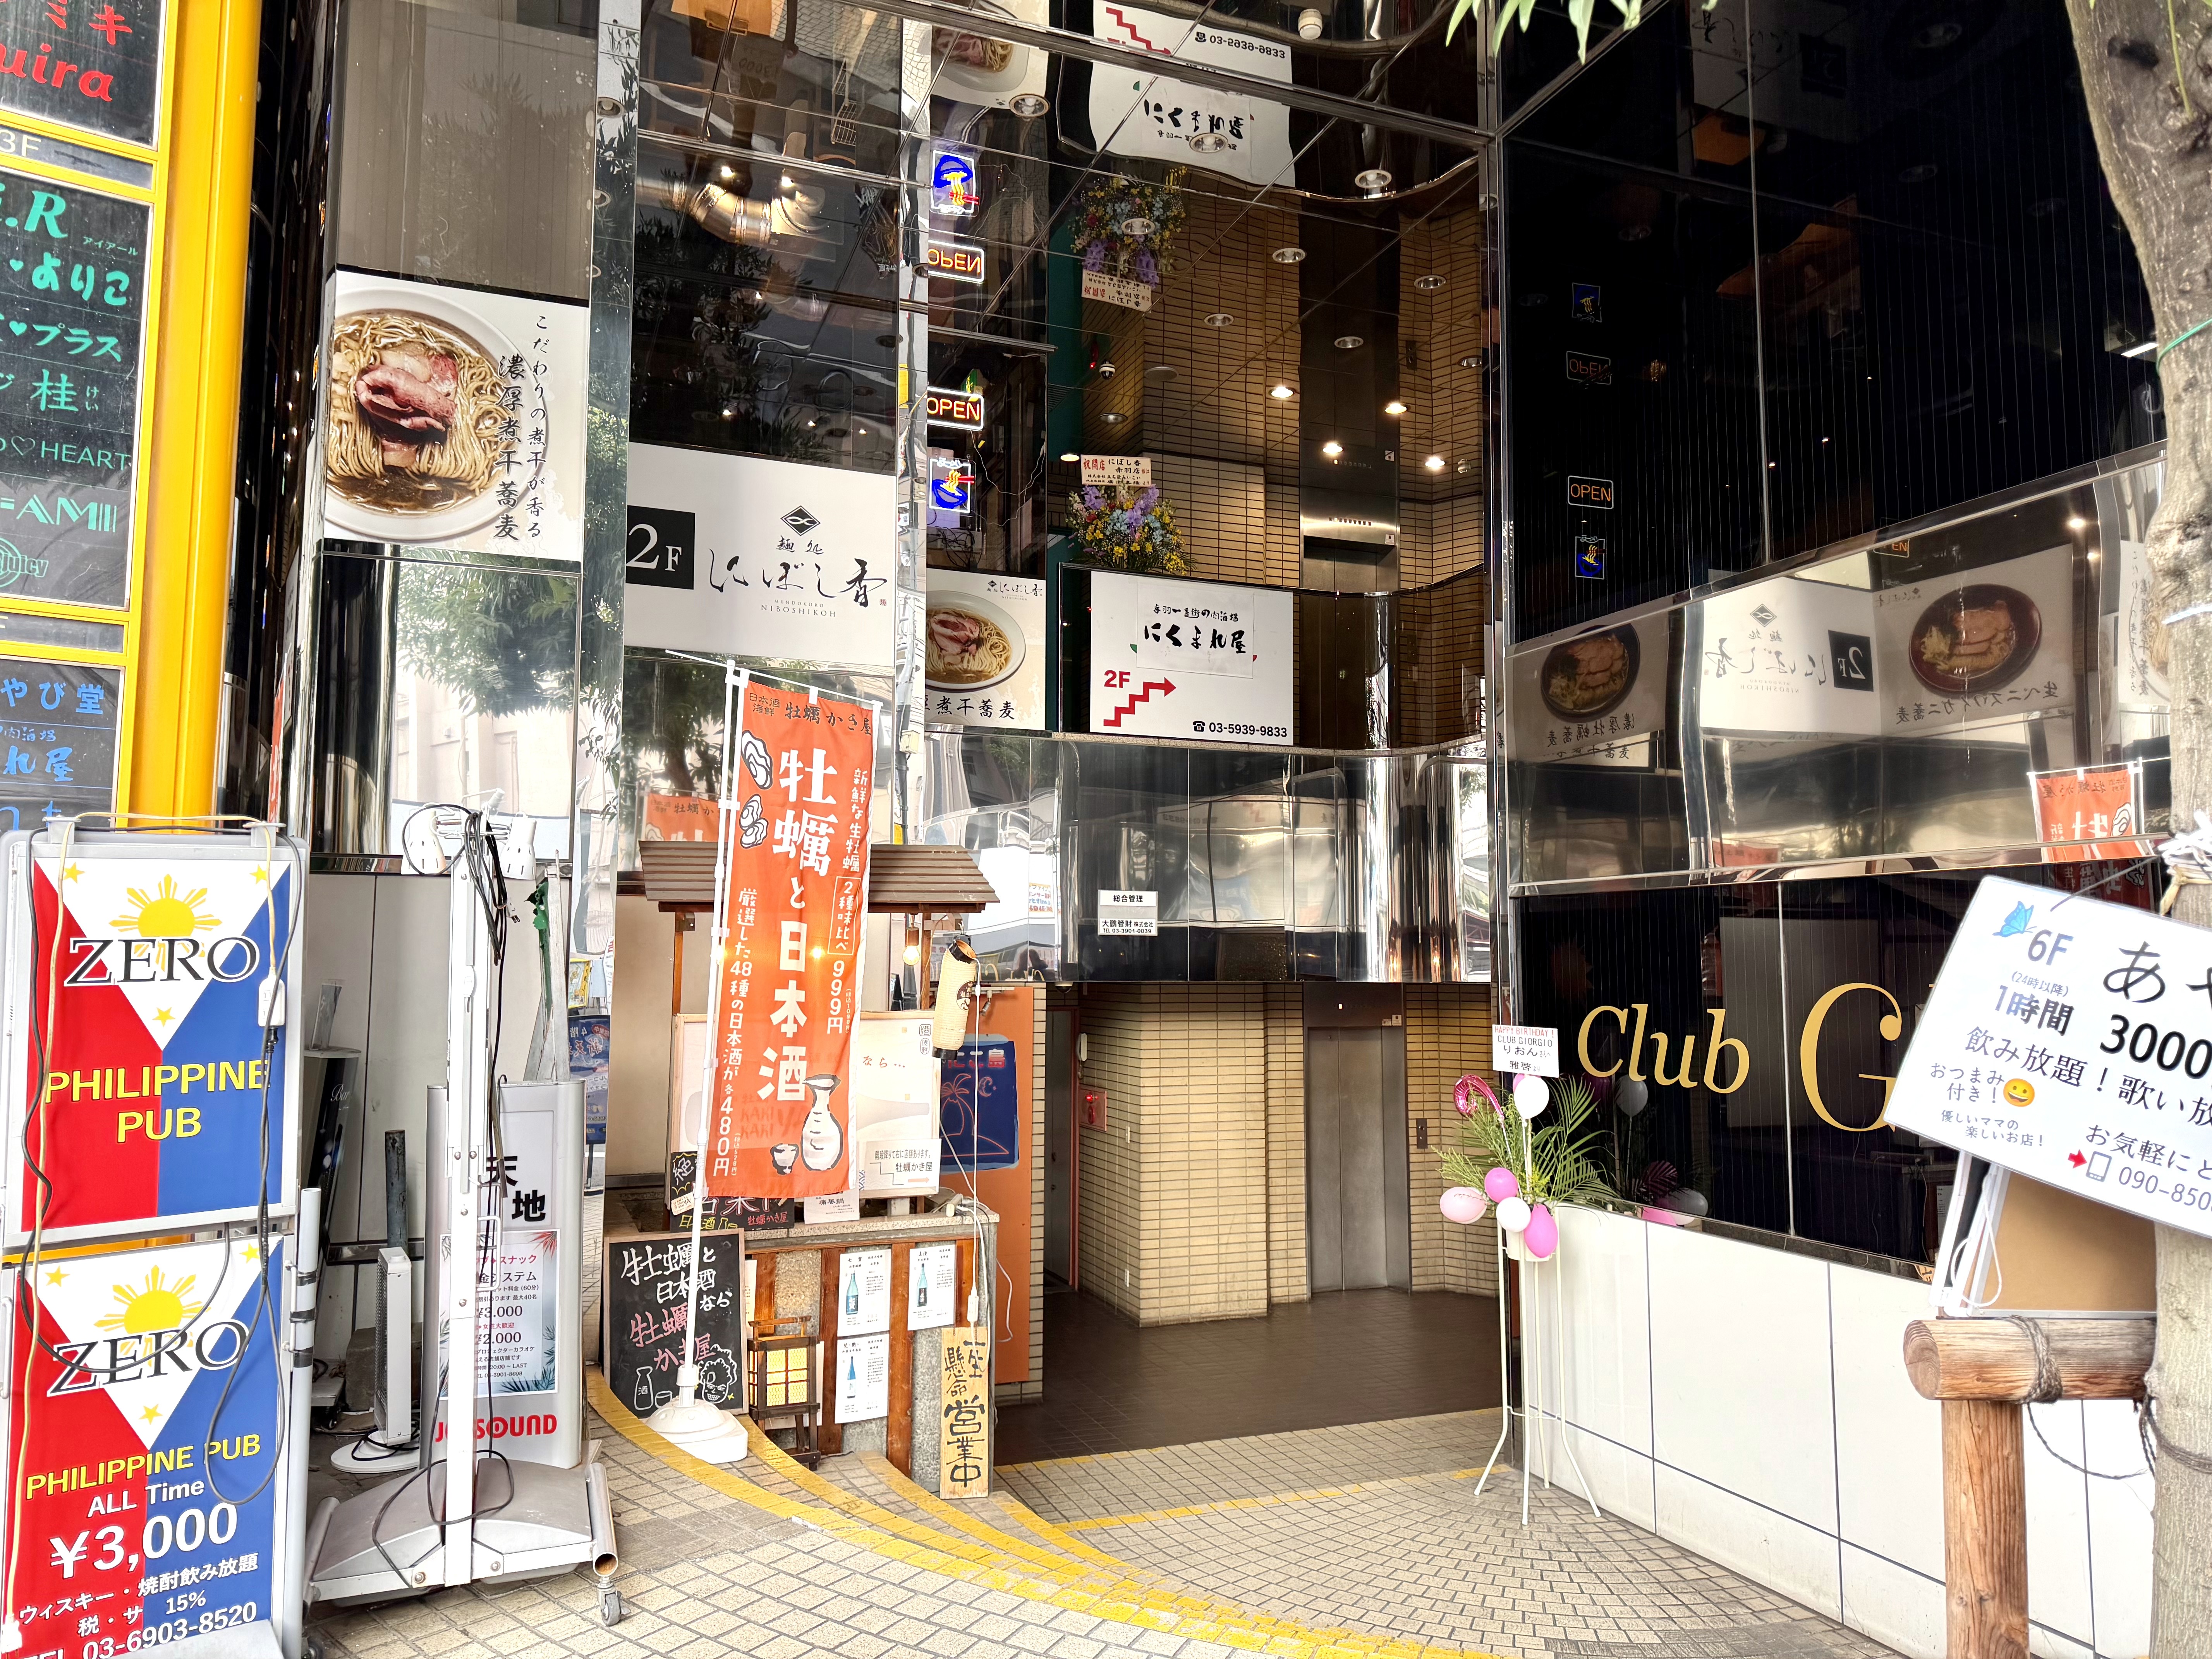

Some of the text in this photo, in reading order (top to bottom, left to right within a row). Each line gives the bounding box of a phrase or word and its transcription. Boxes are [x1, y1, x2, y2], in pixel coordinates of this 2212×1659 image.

[83, 236, 138, 256] アイアール
[32, 252, 130, 306] よりこ
[33, 322, 122, 362] プラス
[525, 314, 550, 538] こだわりの煮干が香る
[926, 397, 981, 421] OPEN
[41, 440, 132, 471] HEART
[493, 354, 526, 541] 濃厚煮干蕎麦
[1083, 458, 1105, 471] 祝開店
[1570, 484, 1611, 501] OPEN
[625, 523, 683, 572] 2F
[708, 548, 888, 608] にぼし香
[761, 603, 836, 618] NIBOSHIKOH
[774, 598, 825, 608] MENDOKORO
[1144, 622, 1247, 654] にくまれ屋
[1103, 670, 1131, 689] 2F
[749, 692, 872, 735] 日本酒 牡蠣かき屋
[752, 704, 775, 716] 海鮮
[1209, 722, 1288, 737] 03-5939-9833
[842, 768, 868, 872] 新鮮な生牡蠣
[1113, 895, 1144, 903] 総合管理
[757, 748, 838, 1101] 牡蠣と日本酒
[64, 936, 259, 986] ZERO
[2027, 929, 2074, 966] 6F
[2011, 970, 2069, 998] (24時以降)
[1994, 984, 2075, 1036] 1時間
[921, 1025, 931, 1036] 酒
[1495, 1026, 1514, 1034] HAPPY
[1516, 1027, 1548, 1037] BIRTHDAY
[1498, 1035, 1553, 1047] CLUB GIORGIO
[1577, 1003, 1750, 1094] Club
[45, 1059, 269, 1104] PHILIPPINE
[1930, 1062, 2005, 1087] おつまみ
[117, 1107, 202, 1143] PUB
[1941, 1109, 2019, 1131] 優しいママの
[874, 1149, 931, 1161] 階段降りて右に店舗あります。
[895, 1161, 933, 1173] 牡蠣かき屋
[2119, 1166, 2212, 1212] 090-850
[679, 1211, 789, 1230] 日酒 牡蠣かき屋
[621, 1242, 716, 1286] 牡蠣と
[699, 1291, 733, 1311] なら
[630, 1301, 689, 1348] 牡蠣
[47, 1318, 250, 1397] ZERO
[637, 1385, 649, 1396] 酒
[435, 1414, 558, 1443] JSOUND
[943, 1394, 986, 1488] 営業中
[26, 1434, 261, 1500] PHILIPPINE PUB
[88, 1480, 205, 1518] ALL Time
[49, 1501, 238, 1579] ¥3,000
[19, 1552, 259, 1625] ウィスキー・焼酎飲み放題
[77, 1590, 206, 1638] 税・サ 15%
[83, 1601, 258, 1659] 03-6903-8520
